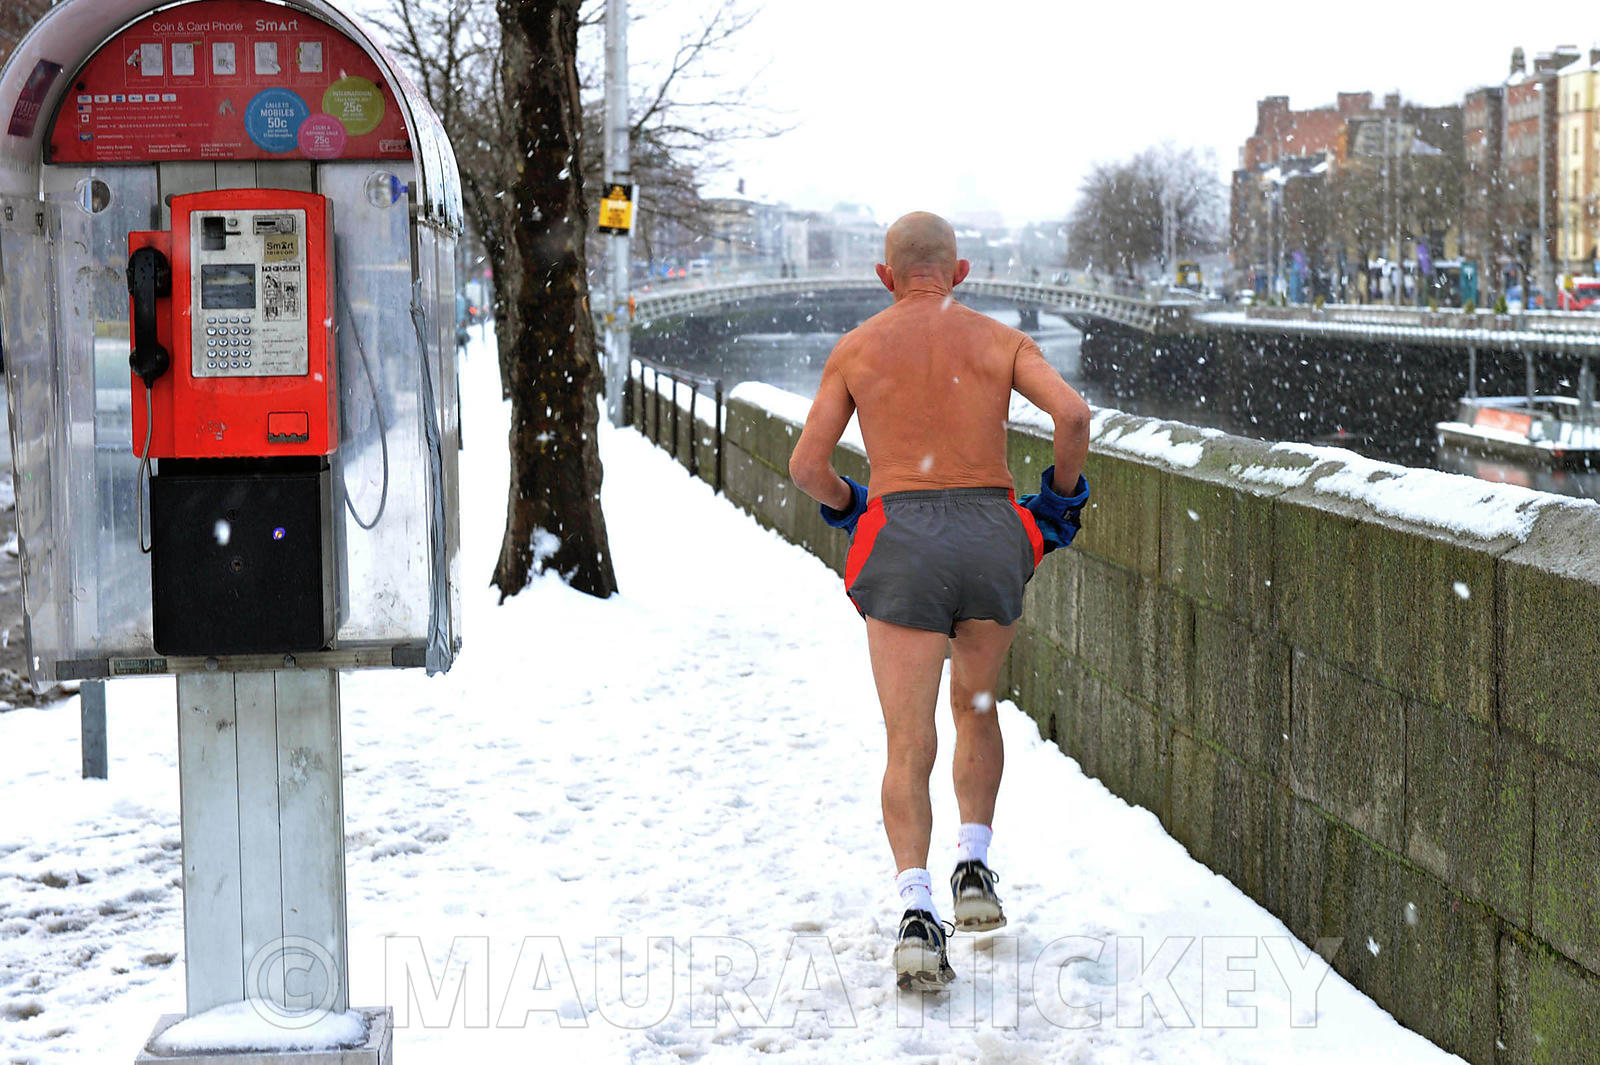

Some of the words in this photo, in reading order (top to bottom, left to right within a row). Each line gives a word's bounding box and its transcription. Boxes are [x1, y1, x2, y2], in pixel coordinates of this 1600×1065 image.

[152, 21, 175, 32] Coin
[177, 22, 184, 32] &
[187, 21, 210, 32] Card
[212, 21, 243, 31] Phone
[255, 19, 299, 32] Smart
[260, 108, 295, 117] MOBILES
[267, 117, 288, 128] 50c
[266, 241, 294, 250] Smart
